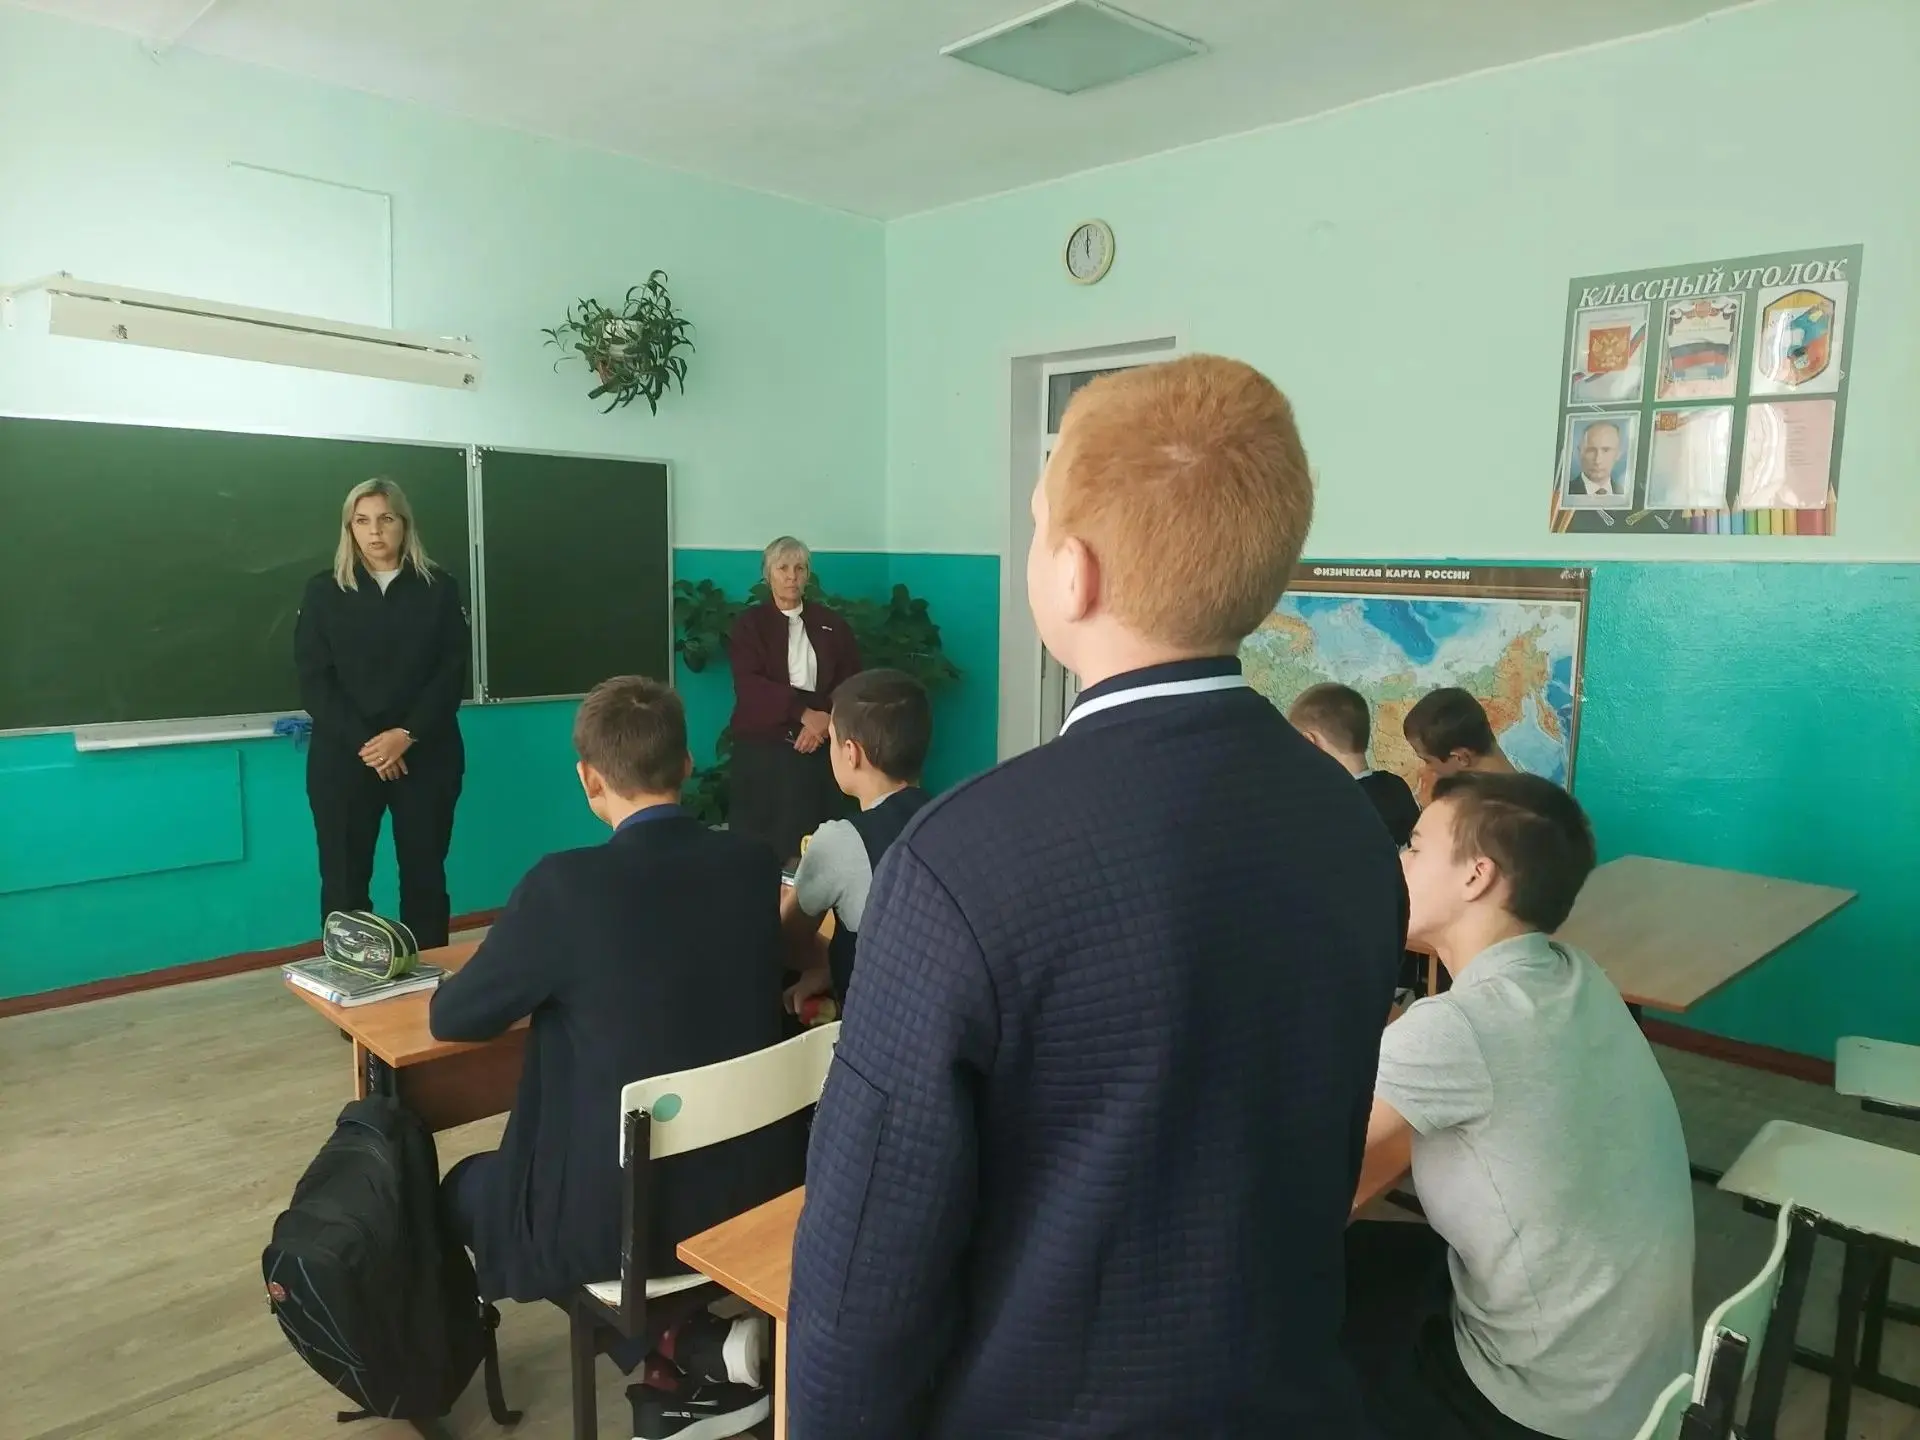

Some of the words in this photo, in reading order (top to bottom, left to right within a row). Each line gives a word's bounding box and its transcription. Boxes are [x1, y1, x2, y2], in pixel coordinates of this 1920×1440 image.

[1579, 265, 1726, 307] КЛАССНЫЙ
[1728, 258, 1848, 291] УГОЛОК
[1313, 567, 1382, 577] ФИЗИЧЕСКАЯ
[1386, 569, 1421, 578] КАРТА
[1425, 570, 1470, 580] РОССИИ
